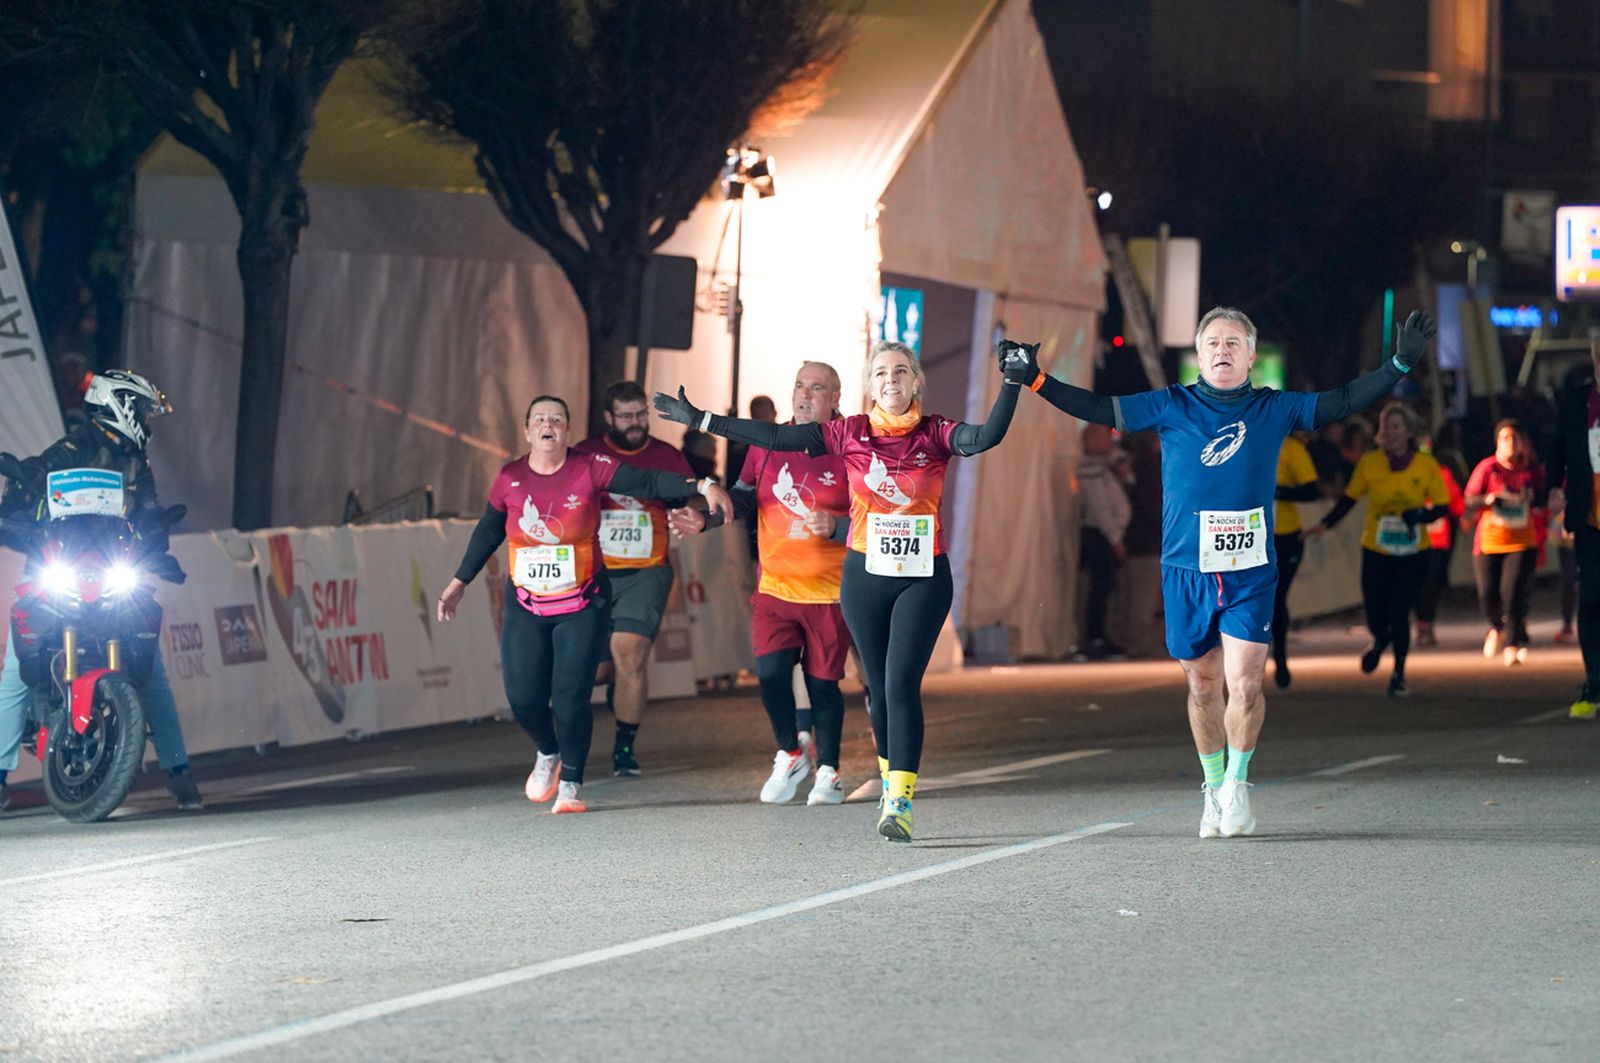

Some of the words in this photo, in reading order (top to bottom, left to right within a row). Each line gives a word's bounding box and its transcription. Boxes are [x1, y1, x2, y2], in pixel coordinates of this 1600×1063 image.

[877, 481, 896, 498] 43
[782, 492, 798, 507] 43
[529, 524, 545, 538] 43
[882, 521, 902, 529] NOCHE
[610, 528, 642, 542] 2733
[1214, 532, 1255, 551] 5373
[880, 537, 921, 556] 5374
[528, 563, 561, 578] 5775
[312, 578, 358, 630] SAN
[170, 622, 204, 653] FISIO
